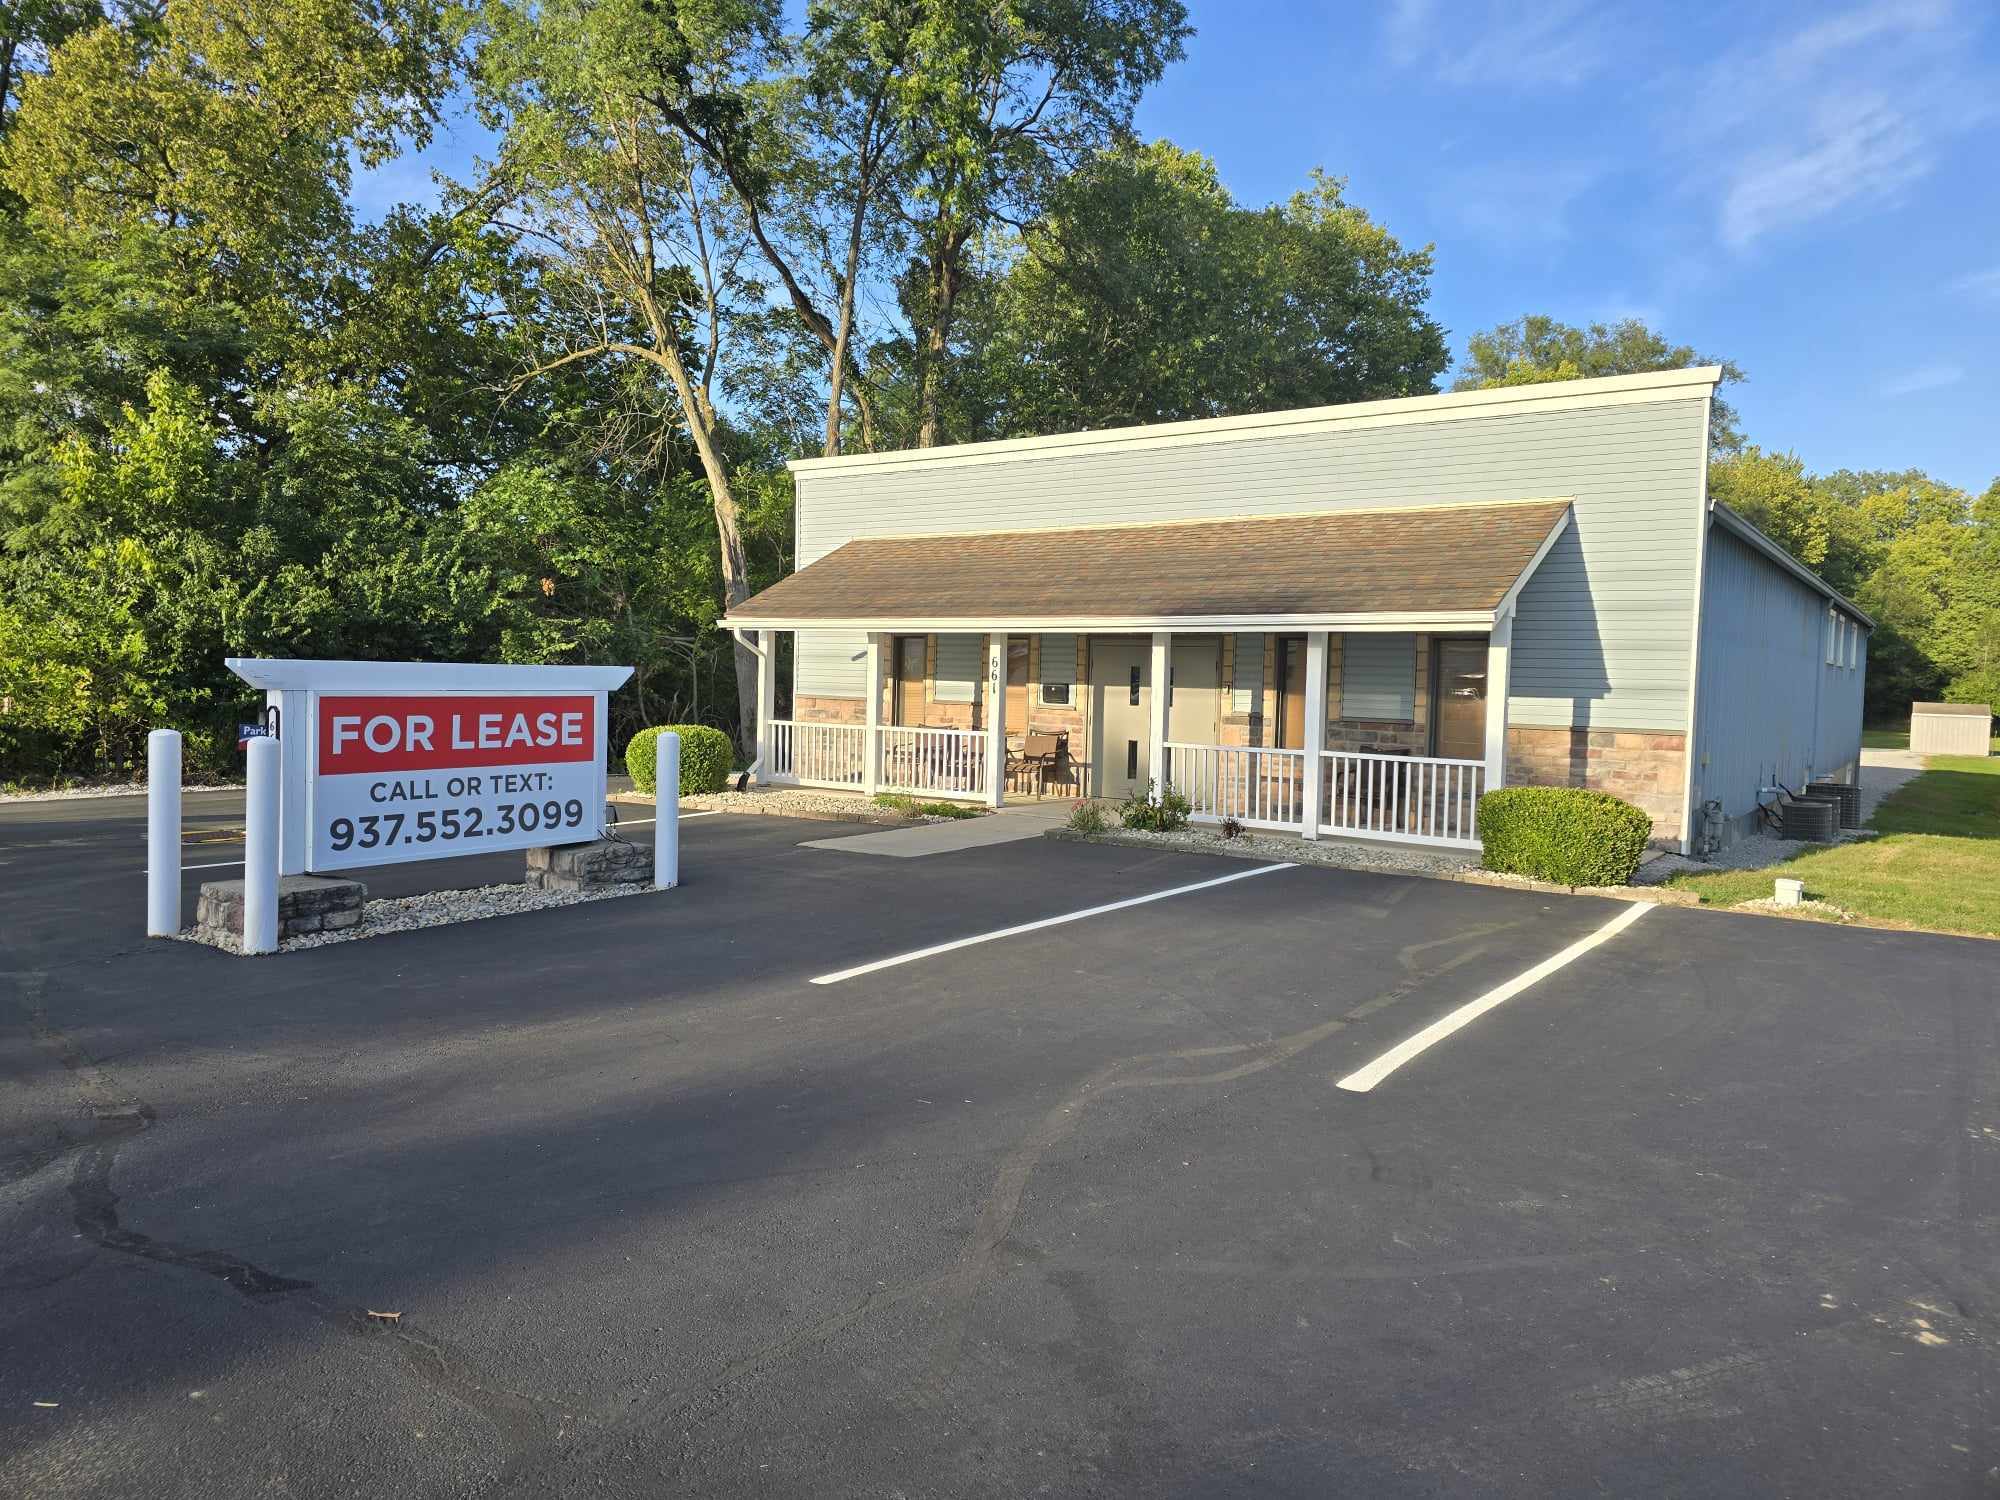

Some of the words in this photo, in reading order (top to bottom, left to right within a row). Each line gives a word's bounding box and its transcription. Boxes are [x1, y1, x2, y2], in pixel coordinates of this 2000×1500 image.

[243, 726, 267, 735] Park
[331, 714, 435, 755] FOR
[451, 711, 584, 750] LEASE
[369, 778, 439, 803] CALL
[446, 776, 482, 798] OR
[489, 772, 554, 795] TEXT:
[329, 798, 584, 852] 937.552.3099
